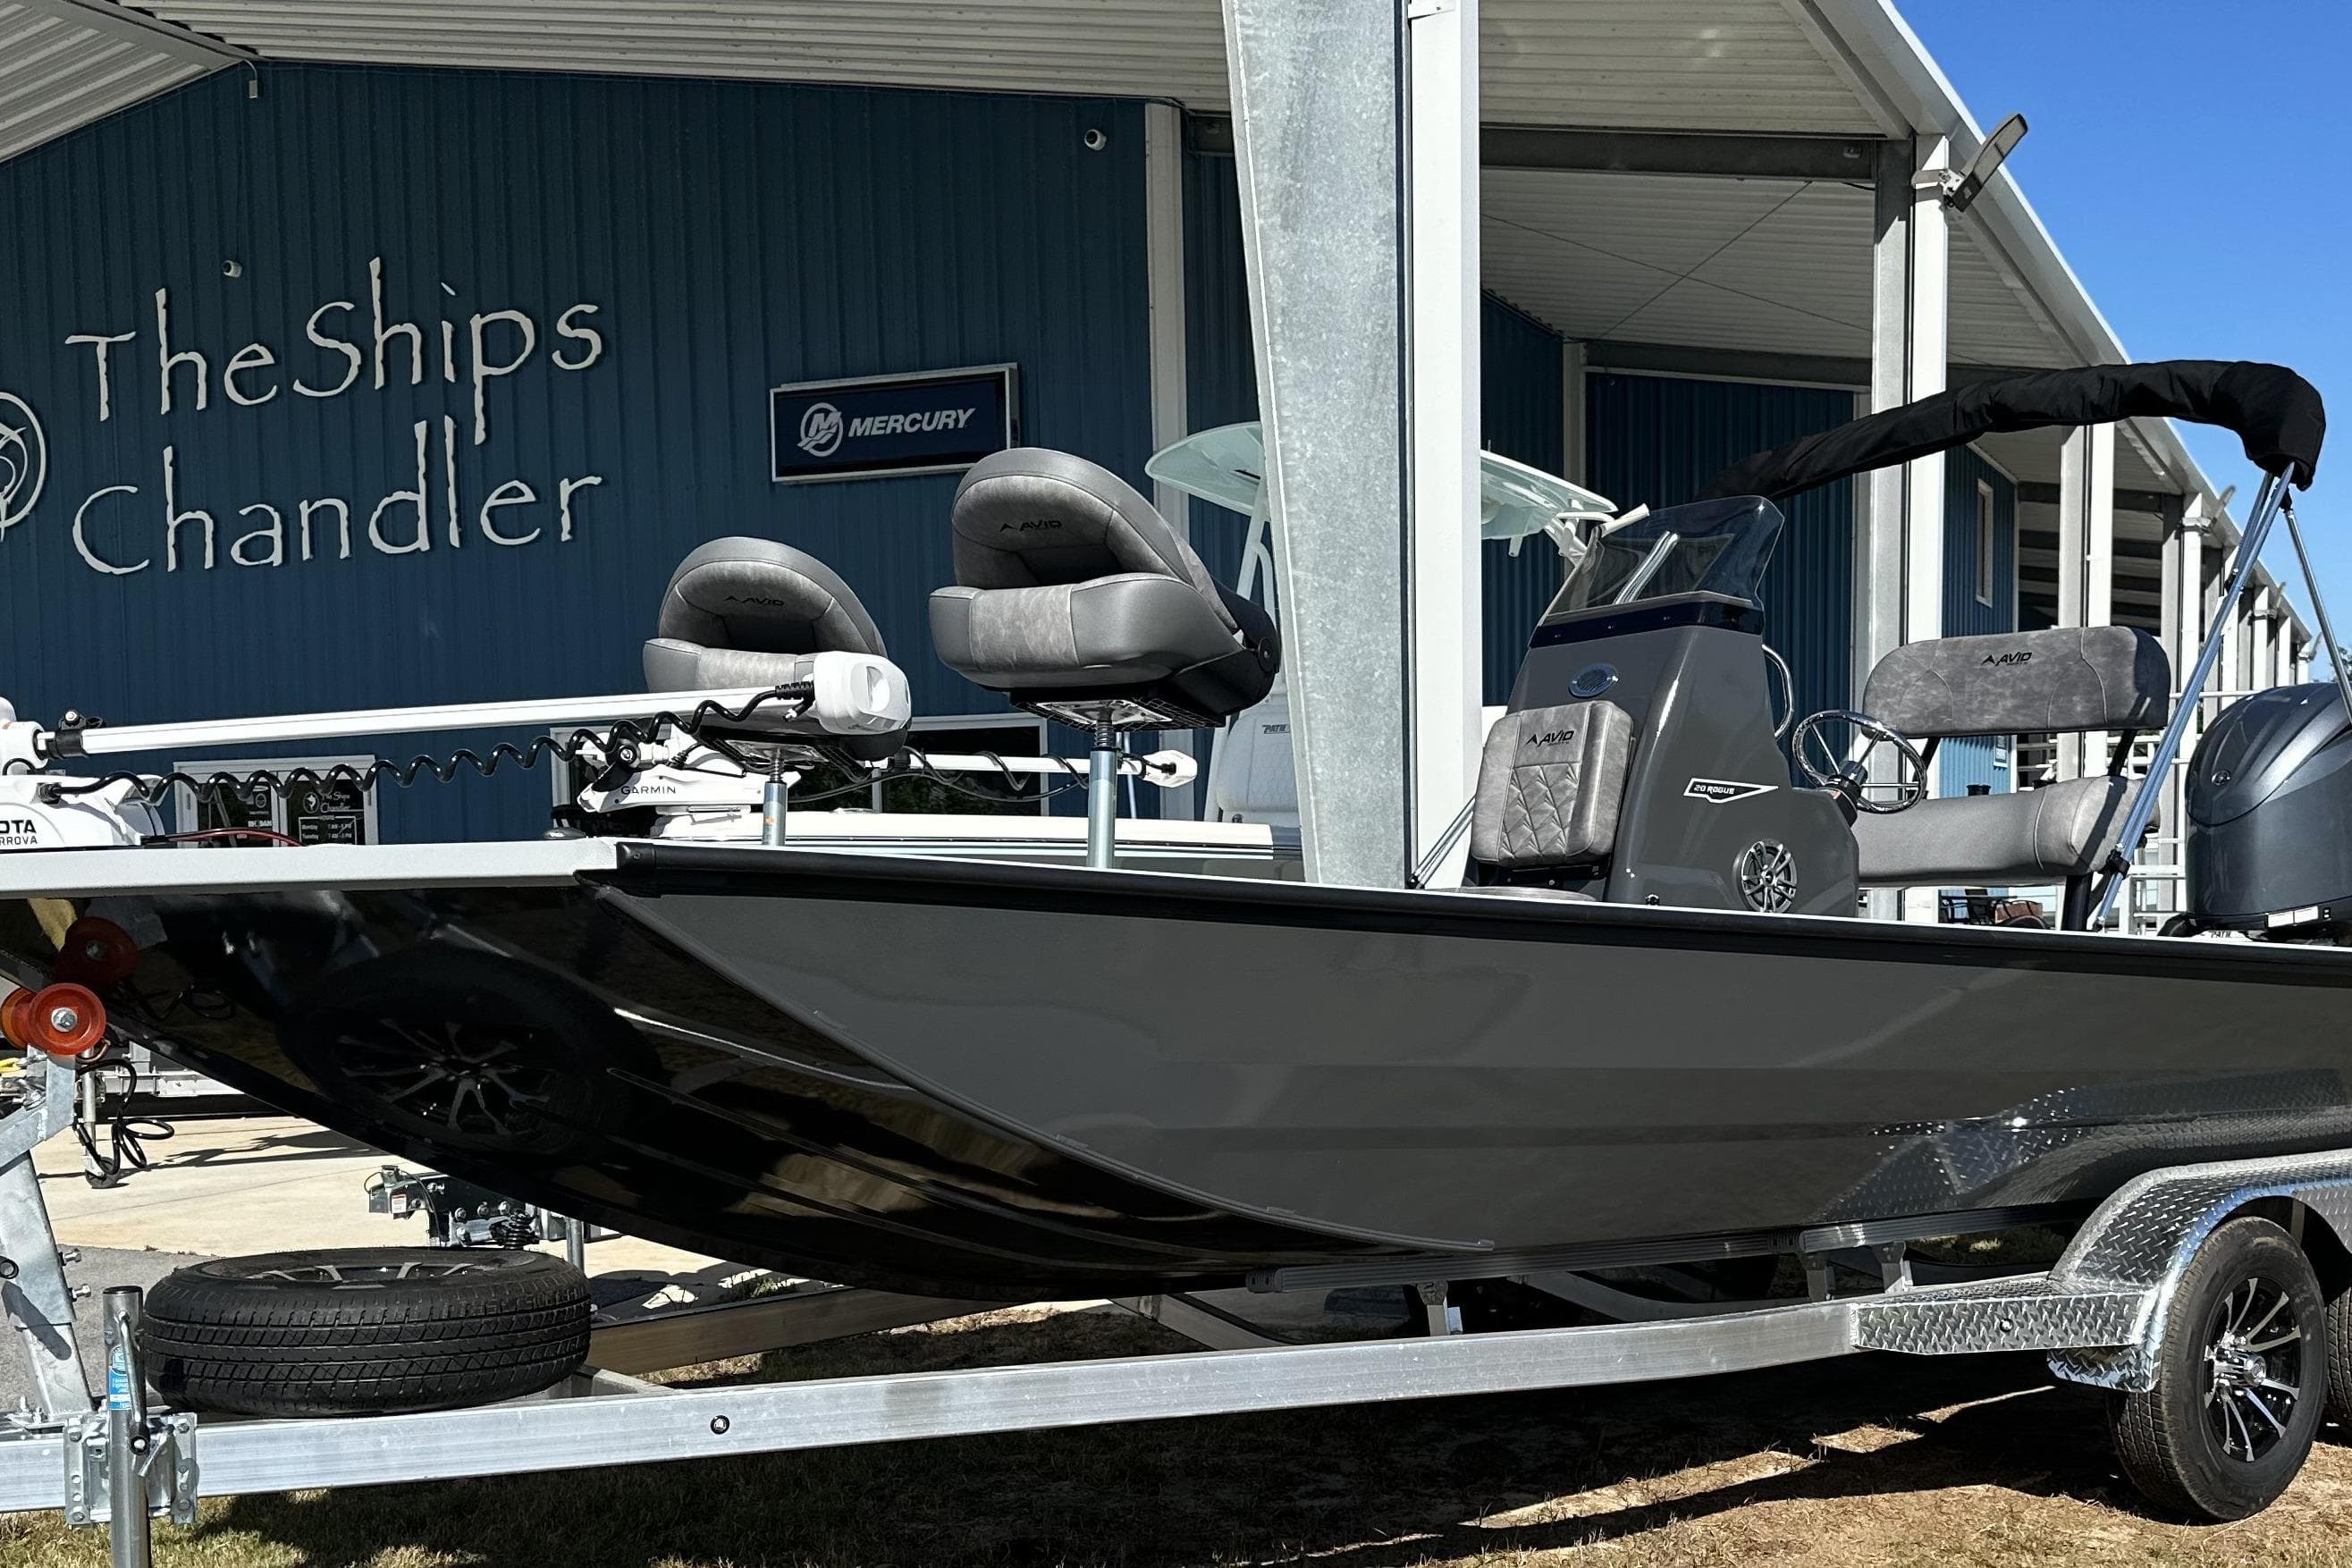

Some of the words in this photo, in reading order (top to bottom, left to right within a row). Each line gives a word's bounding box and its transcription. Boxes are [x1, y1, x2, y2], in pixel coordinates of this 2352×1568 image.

[65, 287, 277, 422] The
[293, 256, 603, 445] Ships
[848, 408, 976, 437] MERCURY
[72, 415, 603, 575] Chandler
[1995, 652, 2033, 666] AVID
[1537, 729, 1575, 747] AVID
[620, 786, 677, 796] GARMIN
[1693, 784, 1707, 792] 20
[1707, 786, 1735, 795] ROGUE
